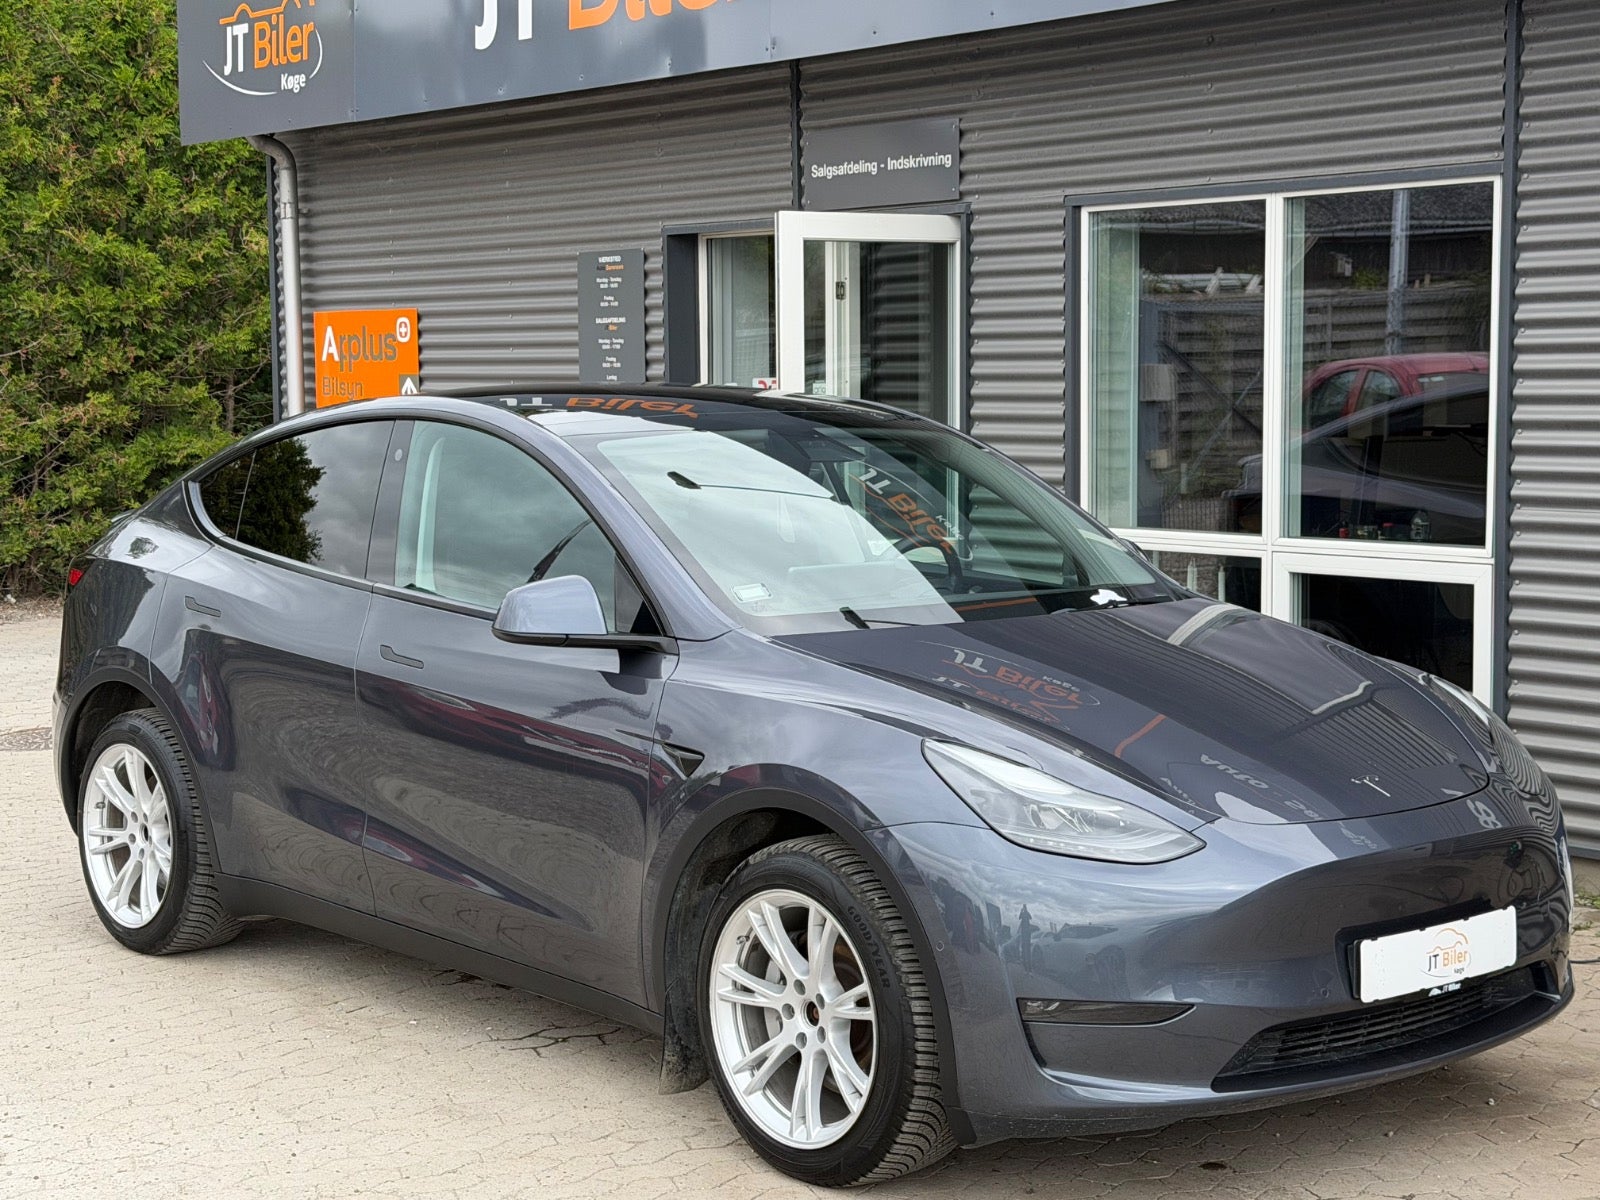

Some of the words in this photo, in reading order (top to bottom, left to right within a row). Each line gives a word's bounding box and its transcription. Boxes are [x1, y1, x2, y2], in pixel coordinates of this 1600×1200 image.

[224, 23, 249, 76] JT
[254, 14, 314, 69] Biler
[281, 73, 306, 93] Køge
[811, 160, 878, 179] Salgsafdeling
[887, 152, 952, 171] Indskrivning
[322, 376, 363, 399] Bilsyn
[1428, 954, 1440, 972] JT
[1443, 949, 1468, 967] Biler
